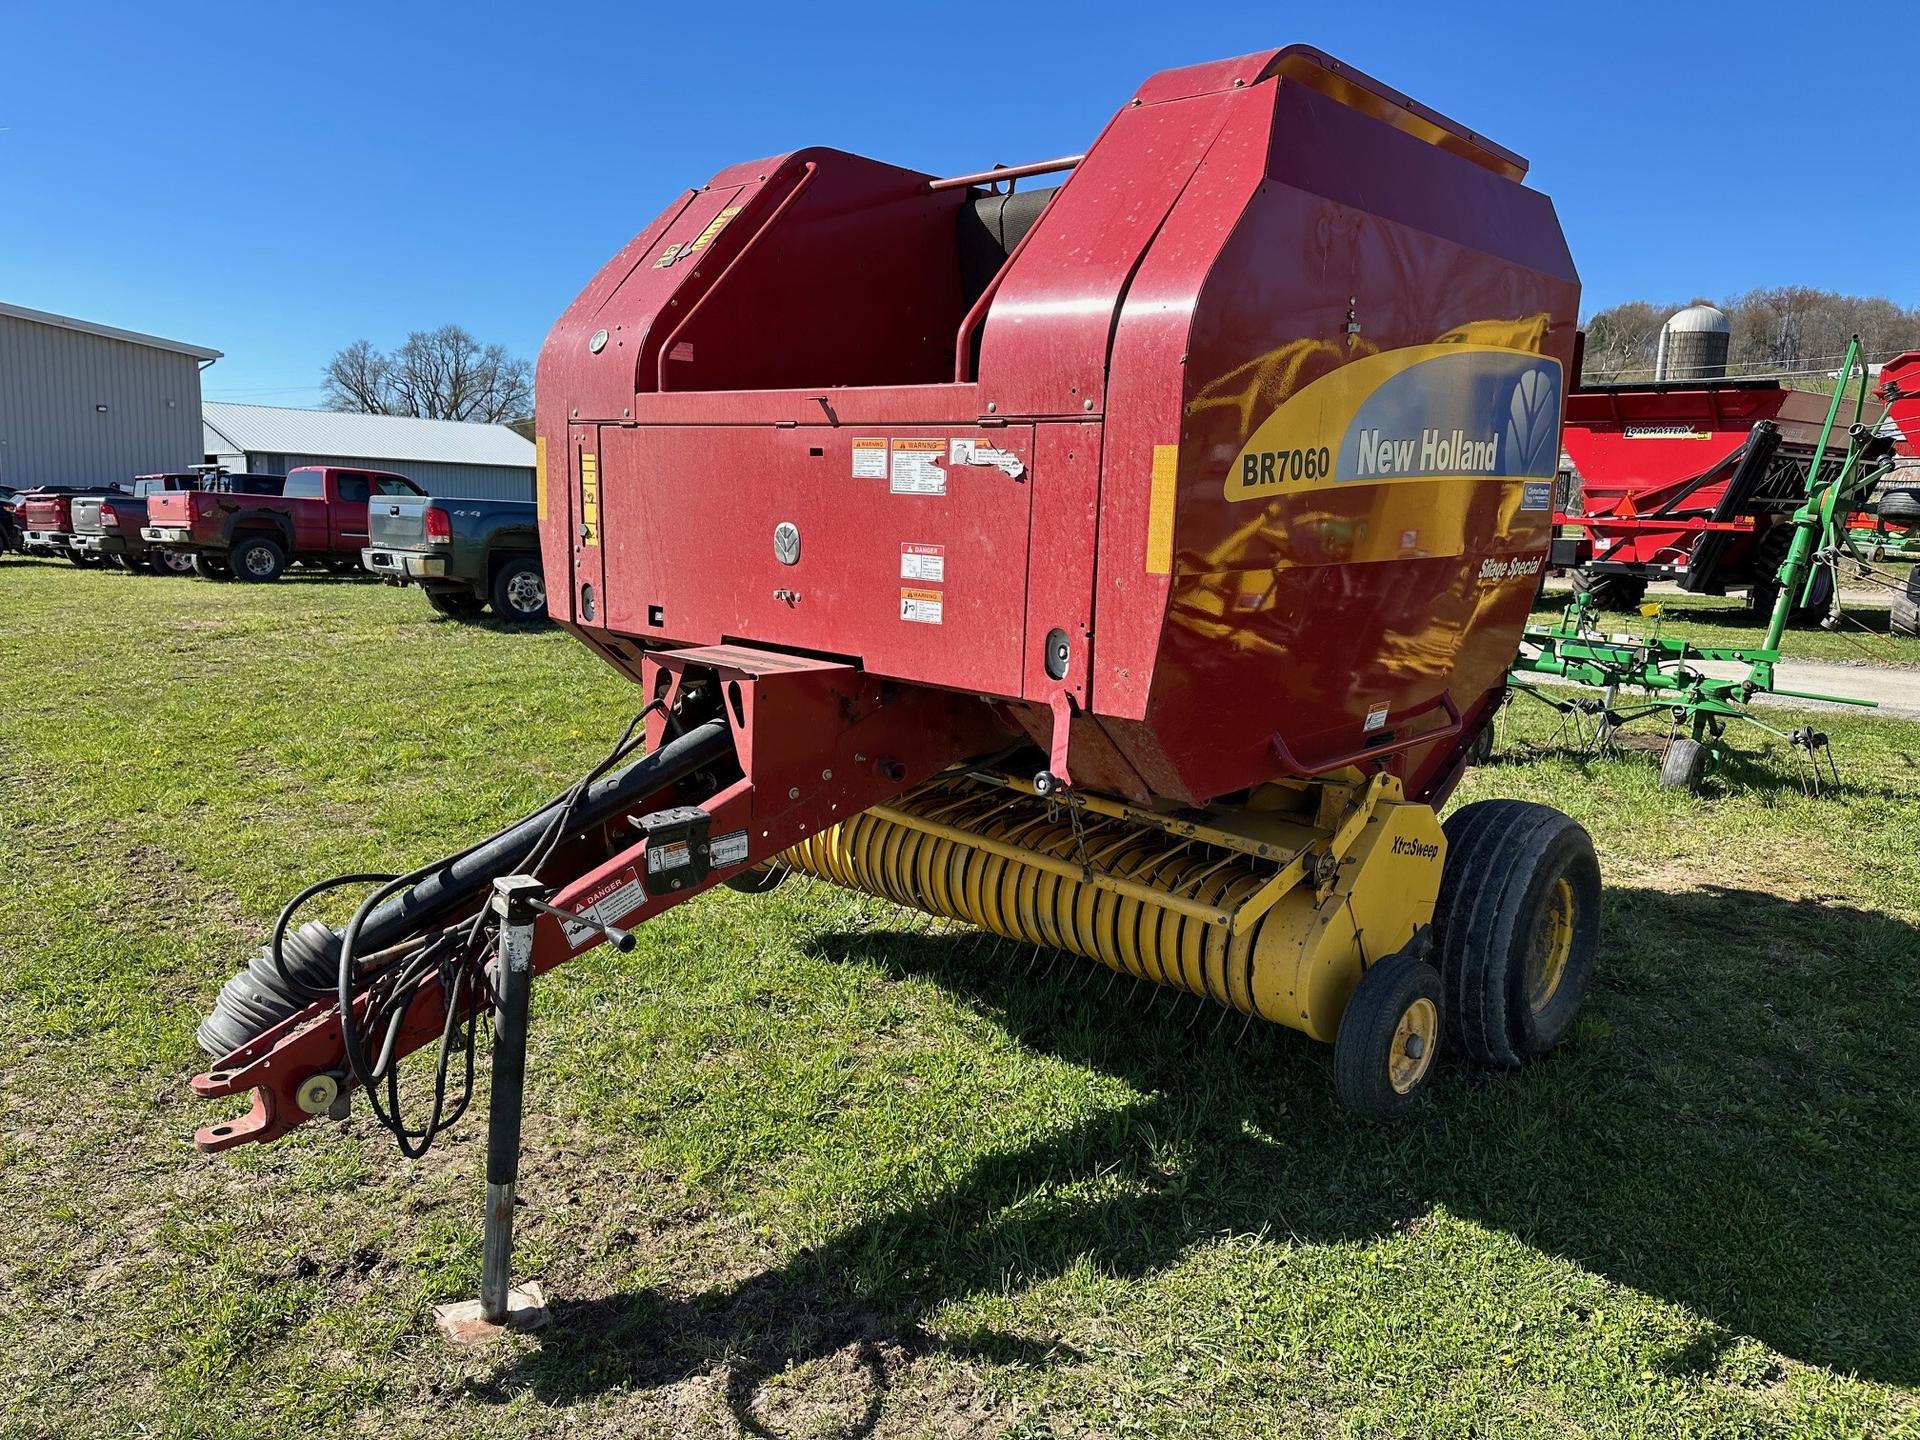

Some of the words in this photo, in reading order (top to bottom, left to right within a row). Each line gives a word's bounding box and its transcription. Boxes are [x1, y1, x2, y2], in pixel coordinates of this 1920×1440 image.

[908, 441, 937, 449] WARNING
[1357, 428, 1416, 475] New
[1419, 429, 1499, 471] Holland
[1242, 446, 1330, 487] BR7060
[914, 546, 938, 555] DANGER
[1478, 558, 1508, 582] Silage
[1507, 555, 1543, 580] Special
[913, 592, 938, 600] WARNING
[1390, 836, 1439, 862] XtraSweep
[586, 879, 623, 905] DANGER
